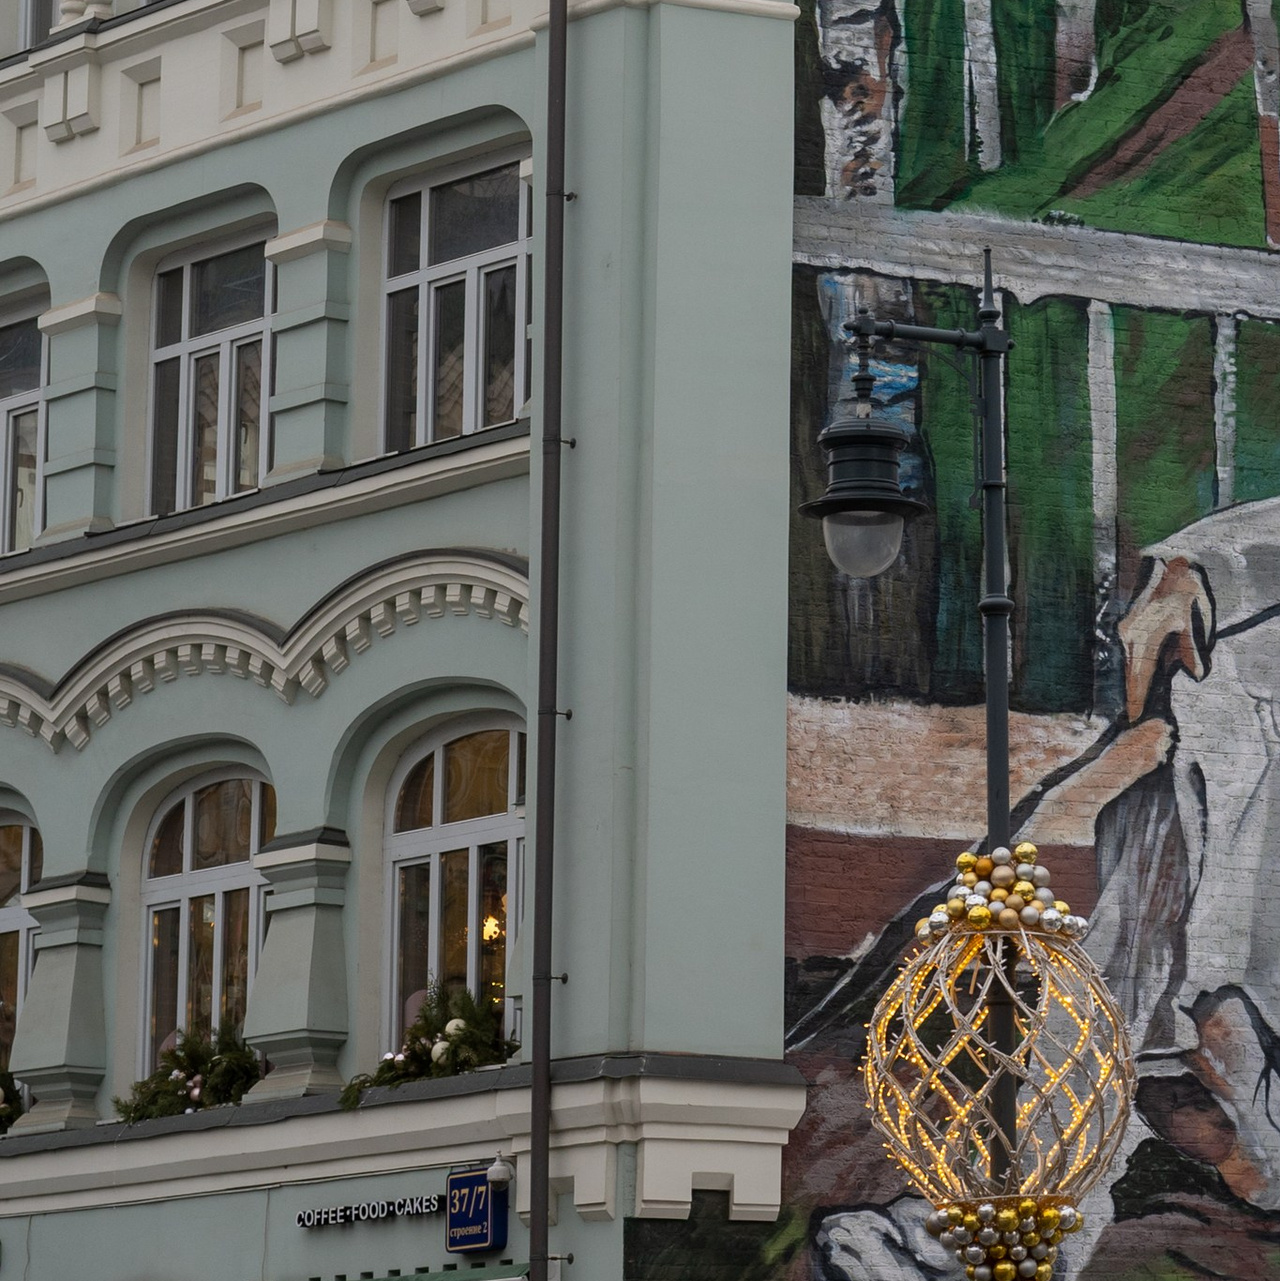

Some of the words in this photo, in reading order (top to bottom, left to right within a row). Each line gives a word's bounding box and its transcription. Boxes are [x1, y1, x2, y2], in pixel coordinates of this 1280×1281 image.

[295, 1206, 345, 1227] COFFEE
[352, 1200, 388, 1221] FOOD
[395, 1194, 439, 1216] CAKES
[451, 1185, 487, 1219] 37/7
[450, 1224, 482, 1240] строение
[482, 1221, 488, 1234] 2
